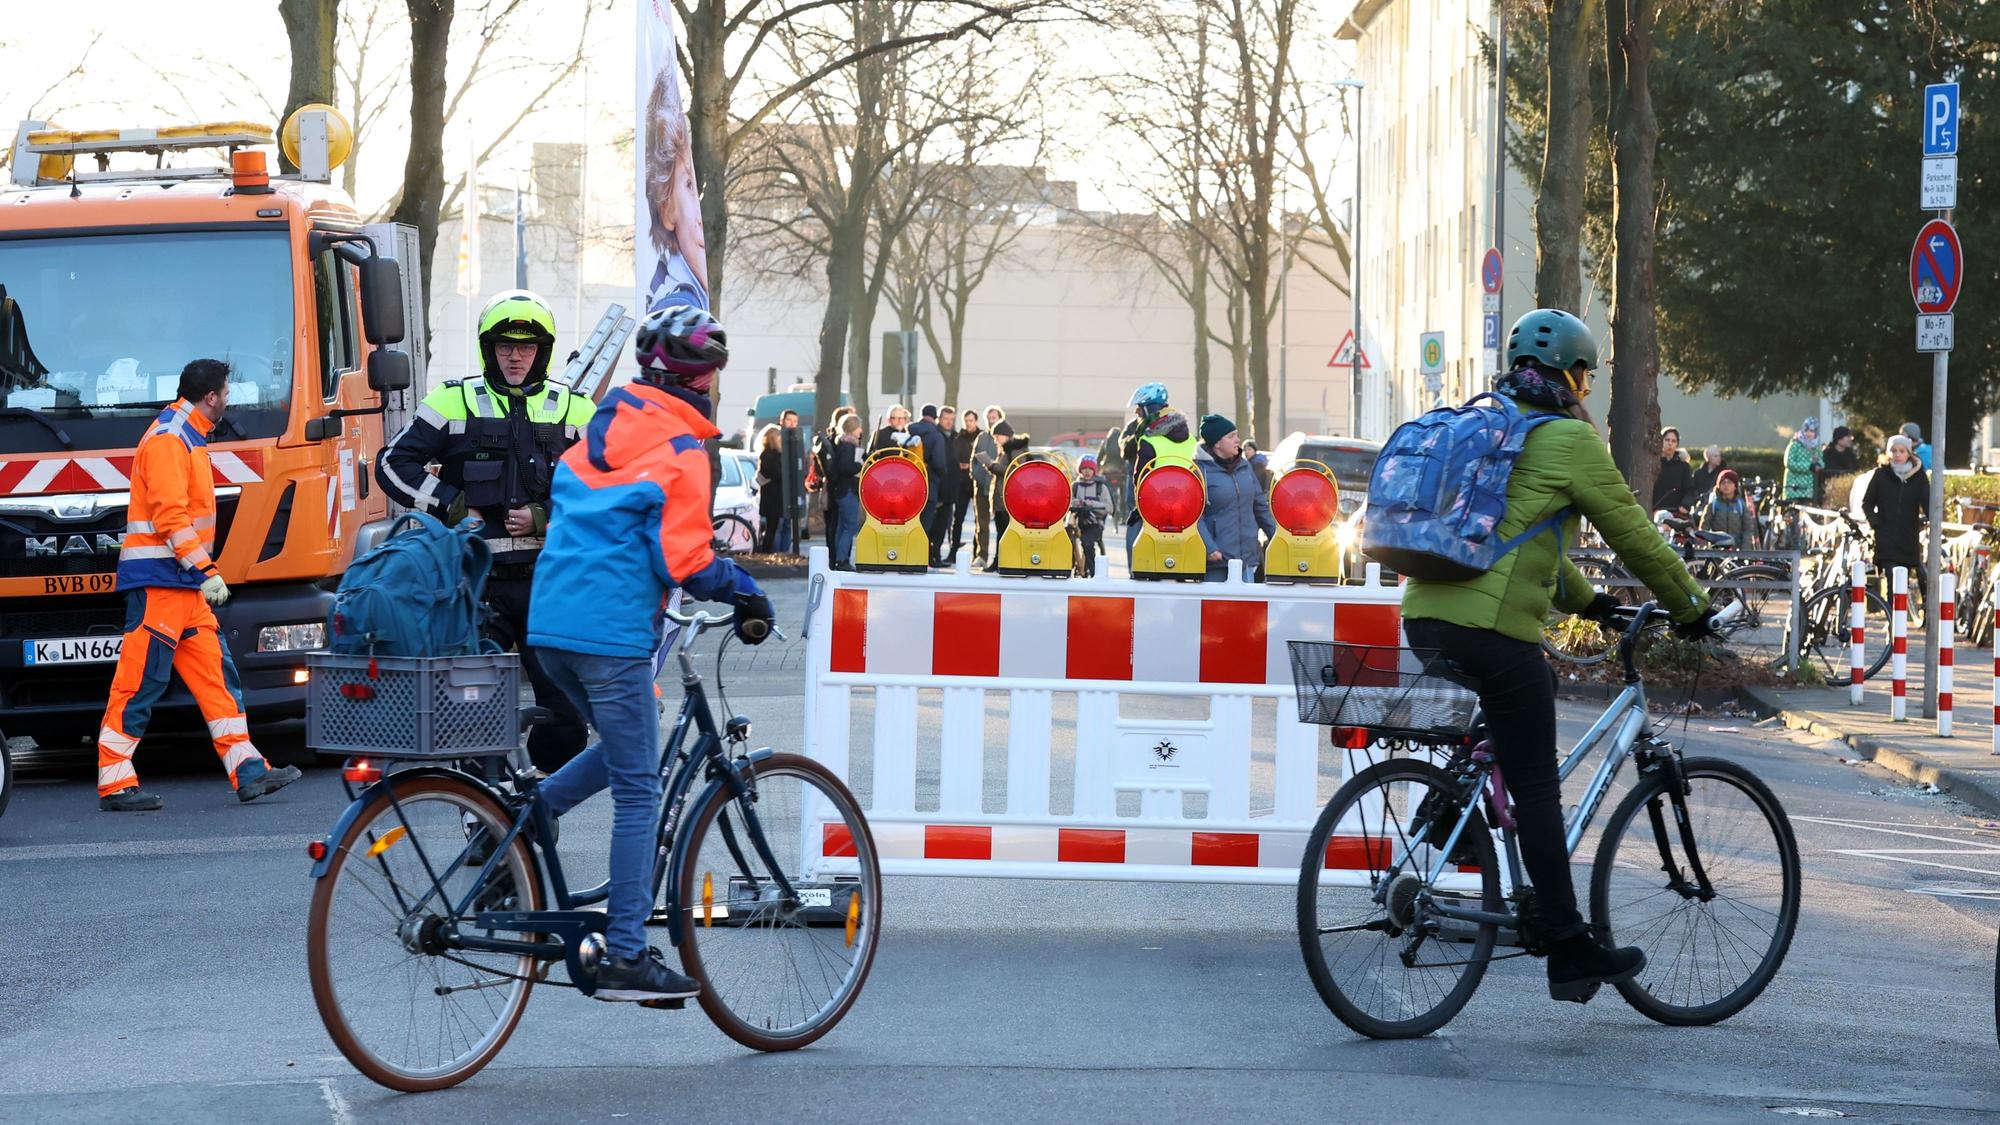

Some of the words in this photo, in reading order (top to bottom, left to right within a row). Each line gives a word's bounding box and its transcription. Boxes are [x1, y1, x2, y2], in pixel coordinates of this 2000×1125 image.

[1931, 94, 1950, 145] P
[1485, 318, 1494, 345] P
[1429, 344, 1437, 361] H
[25, 533, 127, 558] MAN
[44, 576, 84, 594] BVB
[89, 574, 113, 591] 09
[36, 643, 49, 661] K
